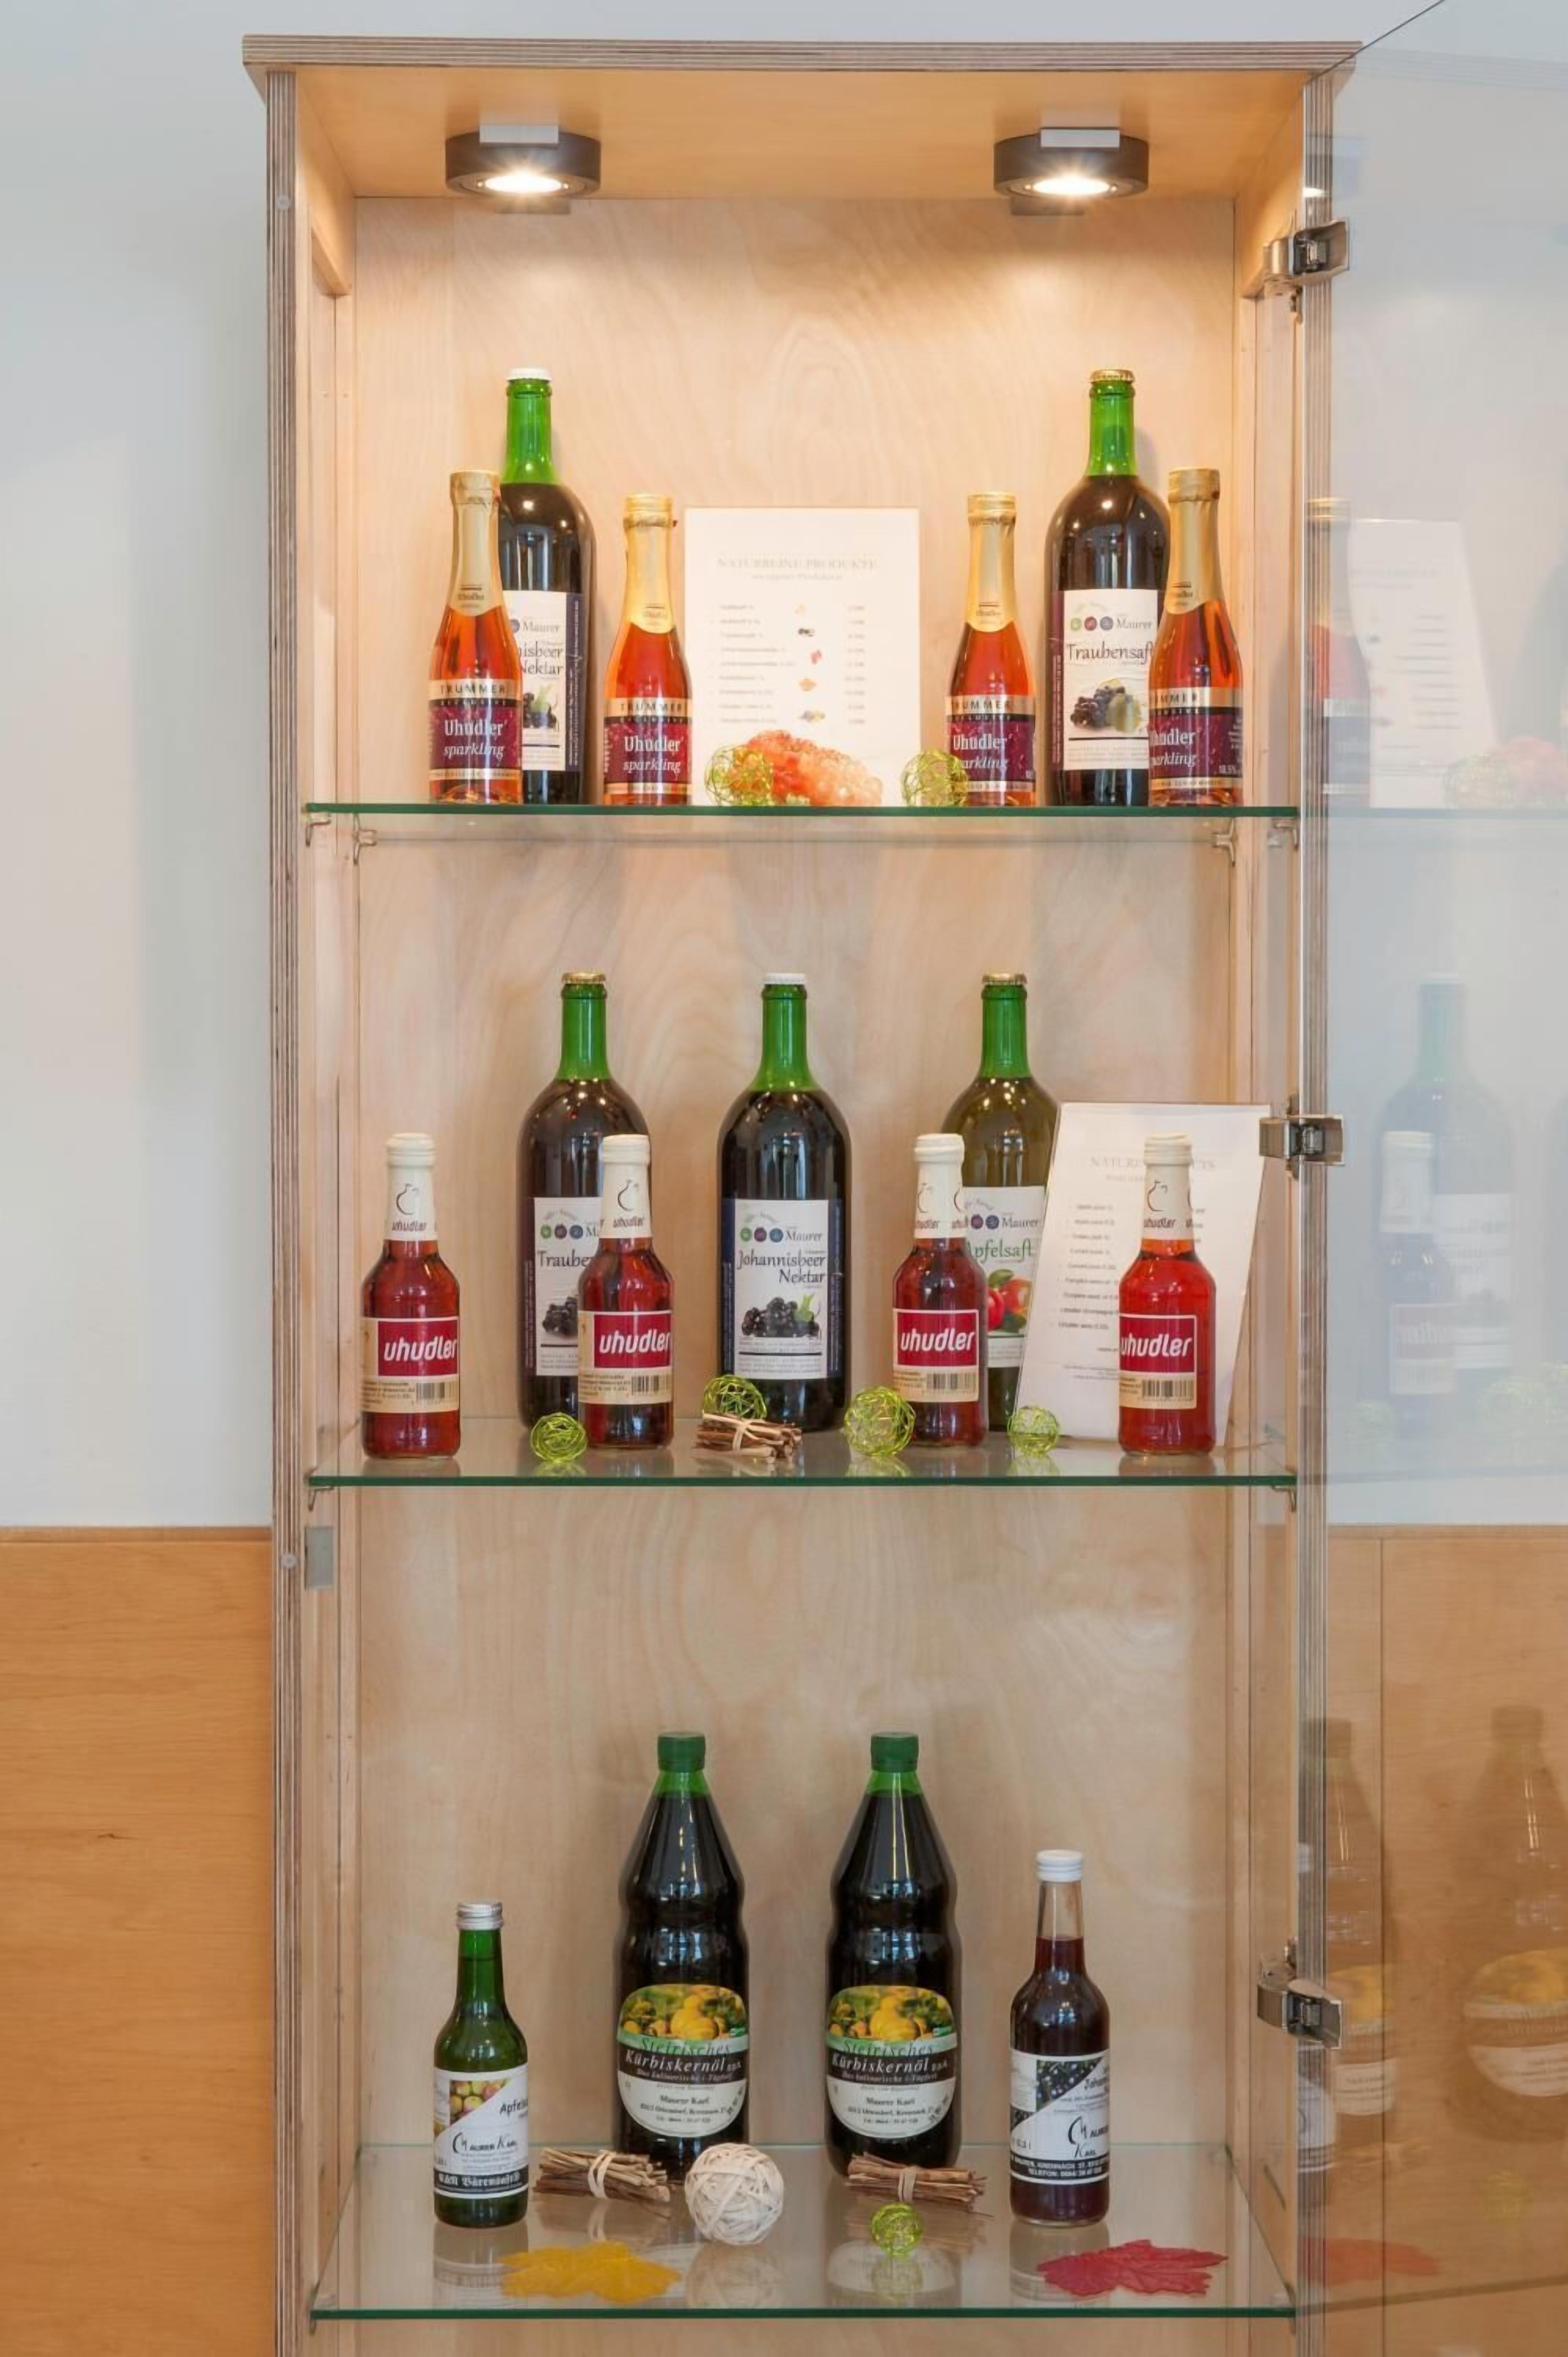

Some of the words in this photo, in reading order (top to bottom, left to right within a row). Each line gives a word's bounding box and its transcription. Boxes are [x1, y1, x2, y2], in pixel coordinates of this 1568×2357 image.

[444, 719, 504, 736] Uhudler
[624, 735, 681, 752] Uhudler
[953, 733, 1008, 750] Uhudler
[786, 1230, 822, 1241] Maurer
[737, 1248, 825, 1270] Johannisbeer
[779, 1269, 826, 1283] Nektar
[383, 1336, 458, 1362] uhudler
[599, 1329, 670, 1354] uhudler
[900, 1328, 975, 1352] uhudler
[1121, 1332, 1192, 1357] uhudler
[832, 2052, 930, 2073] Kürbiskernöl
